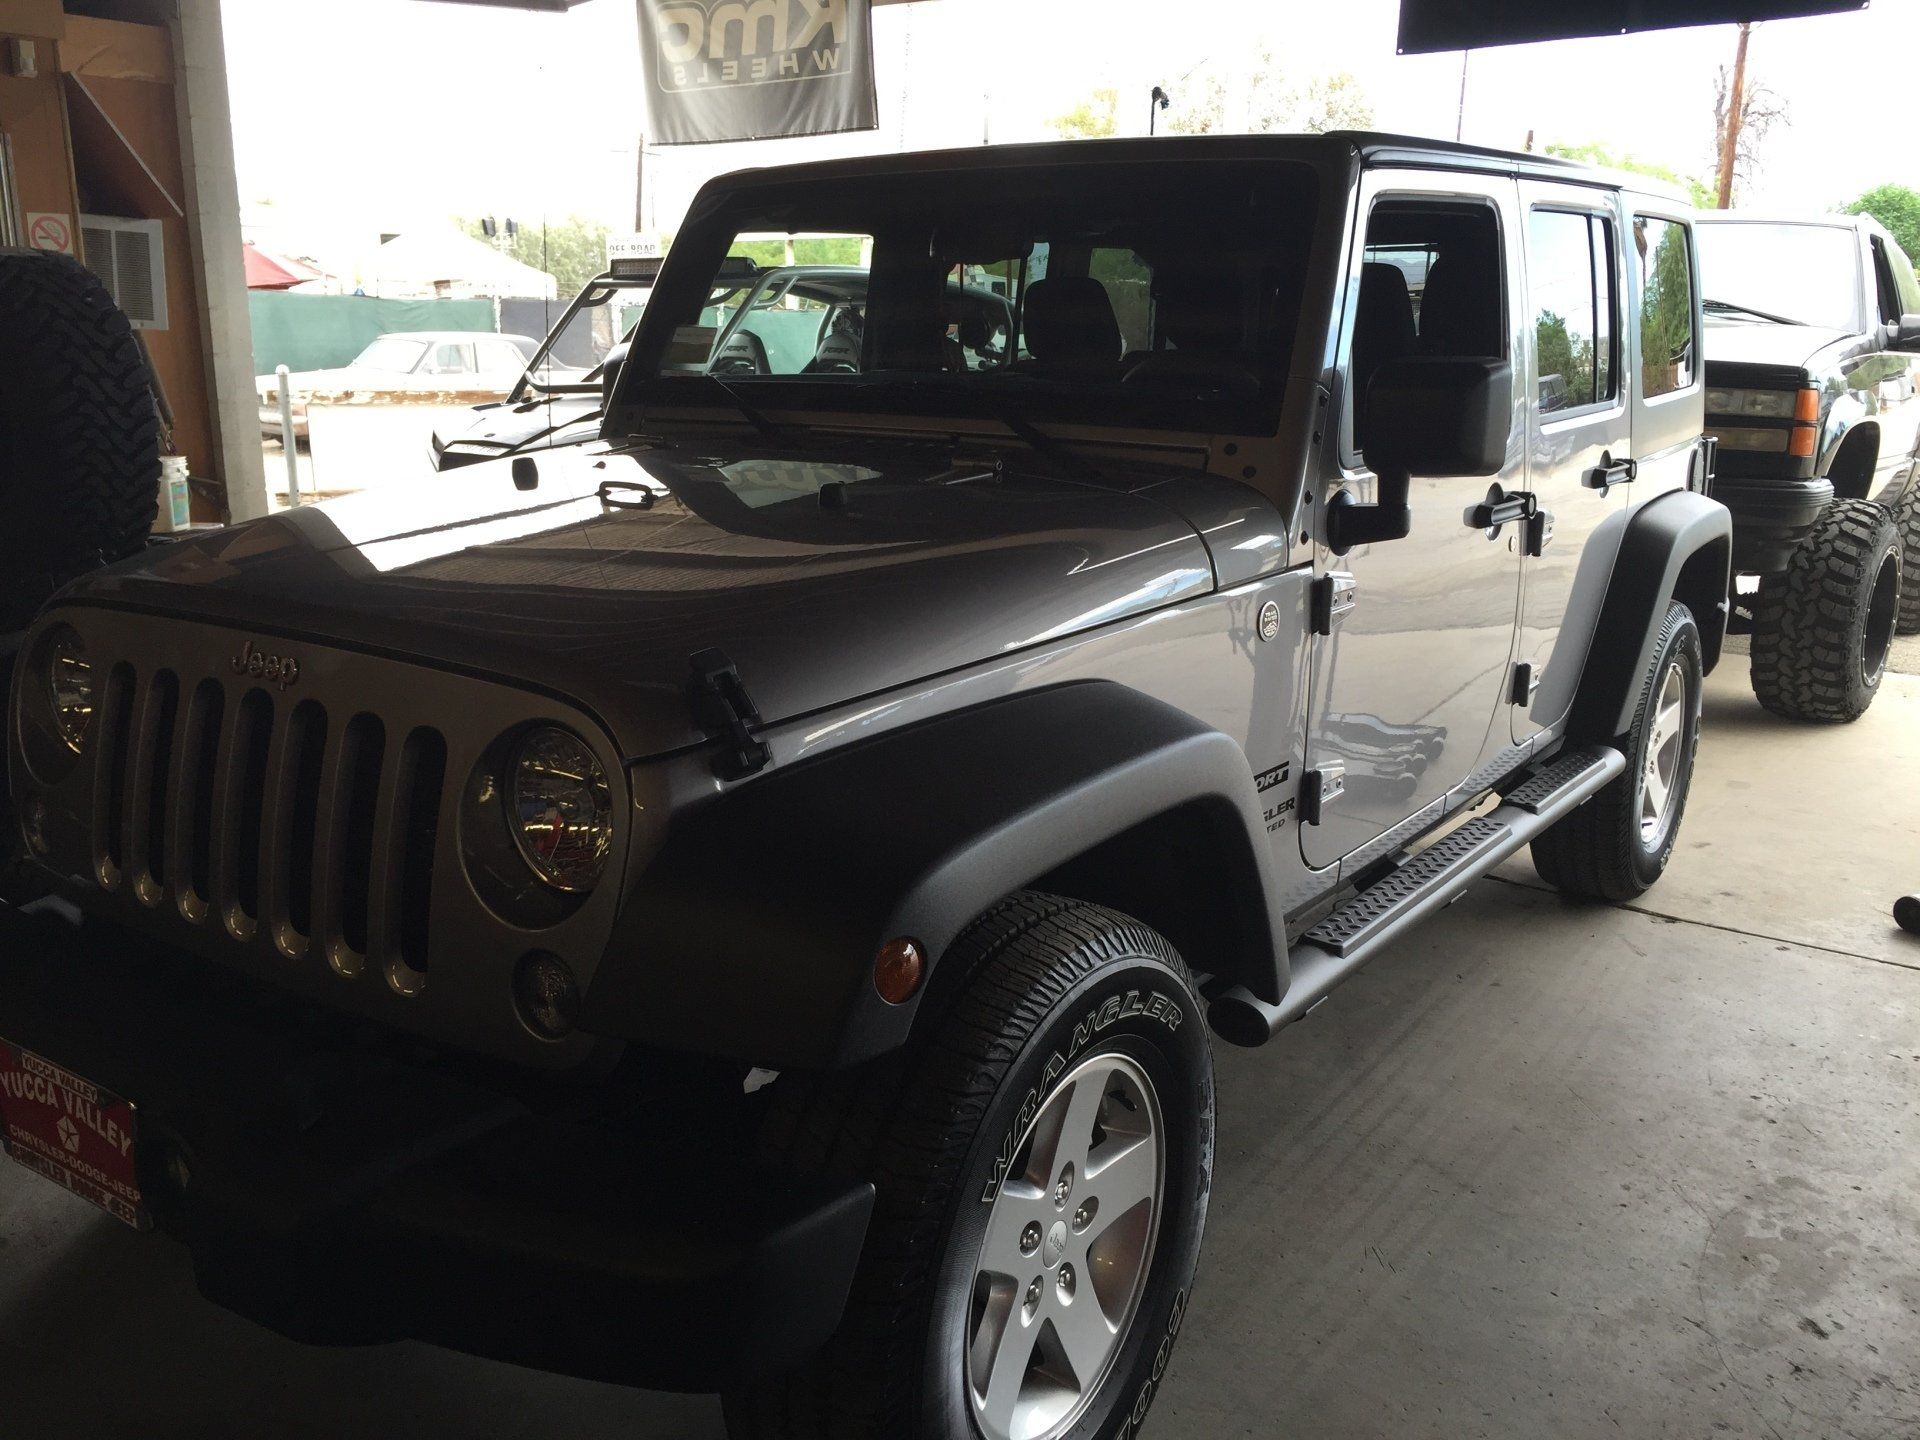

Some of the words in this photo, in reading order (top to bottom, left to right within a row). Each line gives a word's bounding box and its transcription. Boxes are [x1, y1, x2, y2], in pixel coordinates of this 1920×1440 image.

[231, 640, 300, 692] Jeep
[0, 1072, 59, 1108] YUCCA
[61, 1087, 132, 1157] VALLEY
[982, 988, 1183, 1202] WRANGLER
